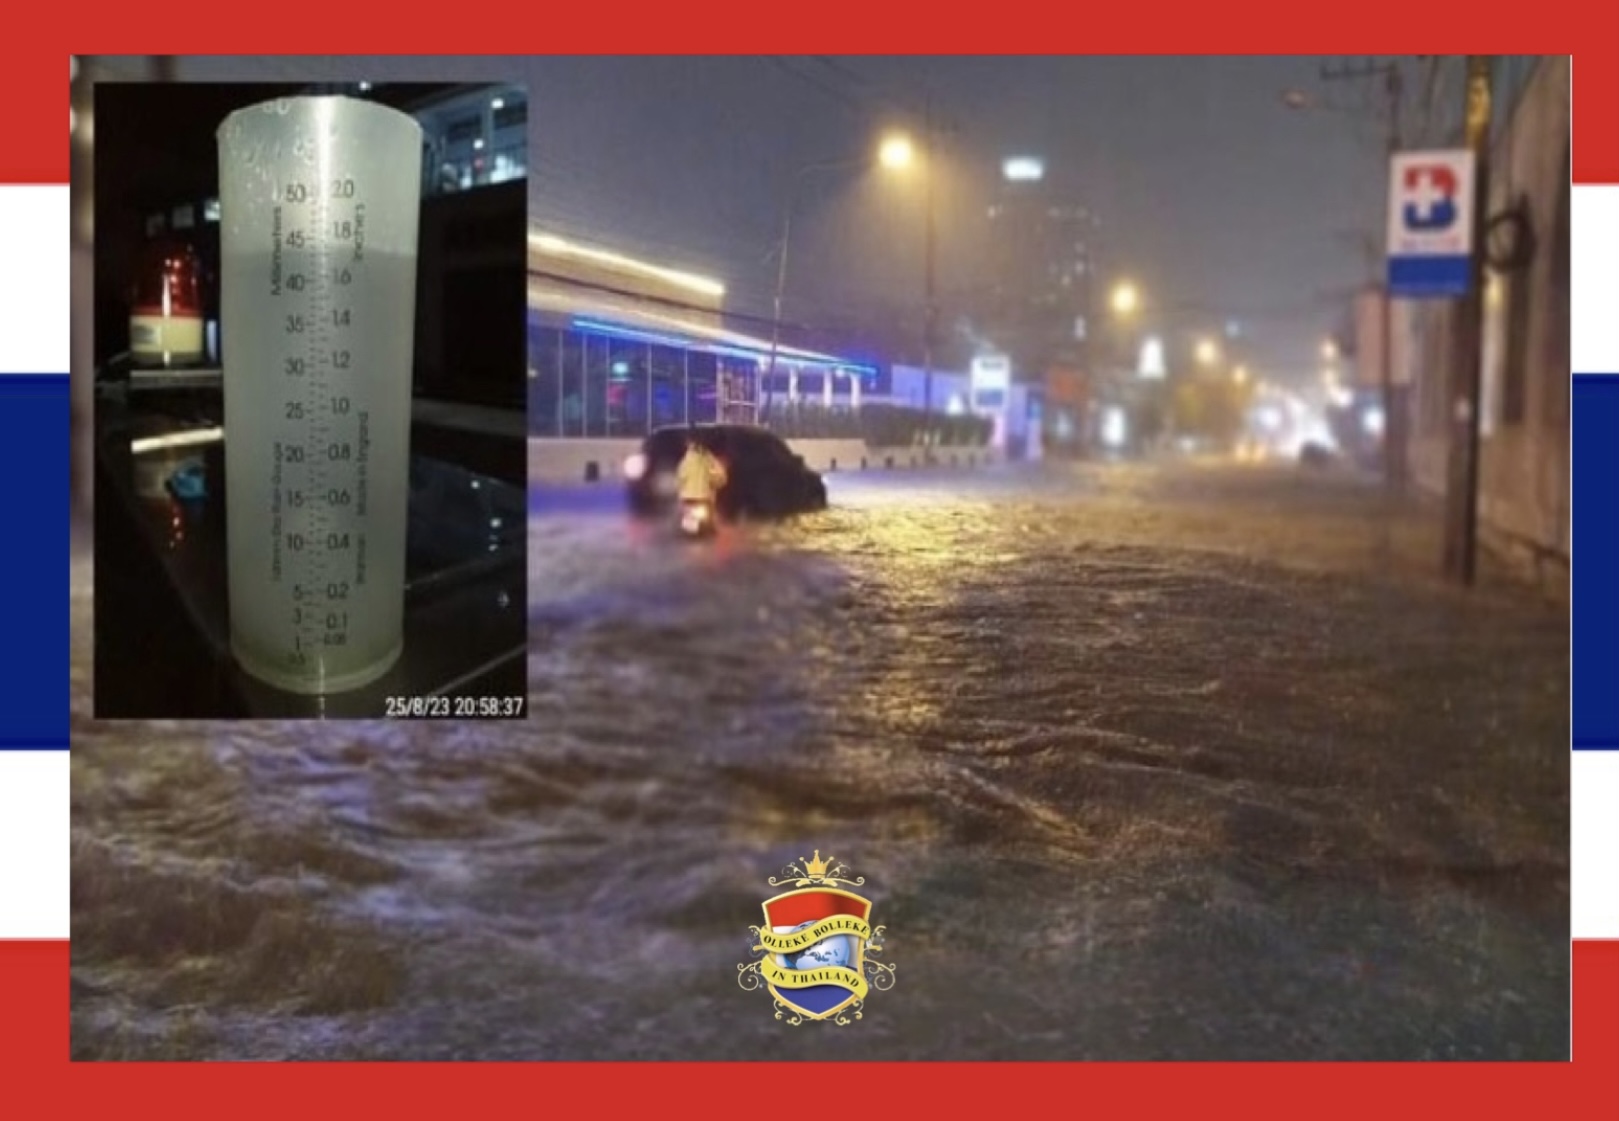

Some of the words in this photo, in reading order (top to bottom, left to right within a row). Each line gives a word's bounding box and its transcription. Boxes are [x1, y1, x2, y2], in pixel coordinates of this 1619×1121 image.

[286, 183, 306, 203] 50
[331, 179, 354, 199] 2.0
[285, 230, 305, 249] 45
[333, 221, 352, 239] 1.8
[285, 273, 306, 292] 40
[332, 268, 352, 286] 1.6
[285, 314, 305, 333] 35
[332, 309, 351, 327] 1.4
[284, 357, 305, 376] 30
[332, 350, 351, 369] 1.2
[284, 402, 305, 420] 25
[331, 397, 351, 415] 1.0
[284, 444, 305, 463] 20
[327, 442, 351, 461] 0.8
[287, 489, 305, 508] 15
[327, 488, 351, 507] 0.6
[287, 533, 305, 552] 10
[327, 532, 350, 551] 0.4
[292, 583, 303, 601] 5
[327, 582, 350, 600] 0.2
[292, 607, 302, 625] 3
[325, 611, 348, 630] 0.1
